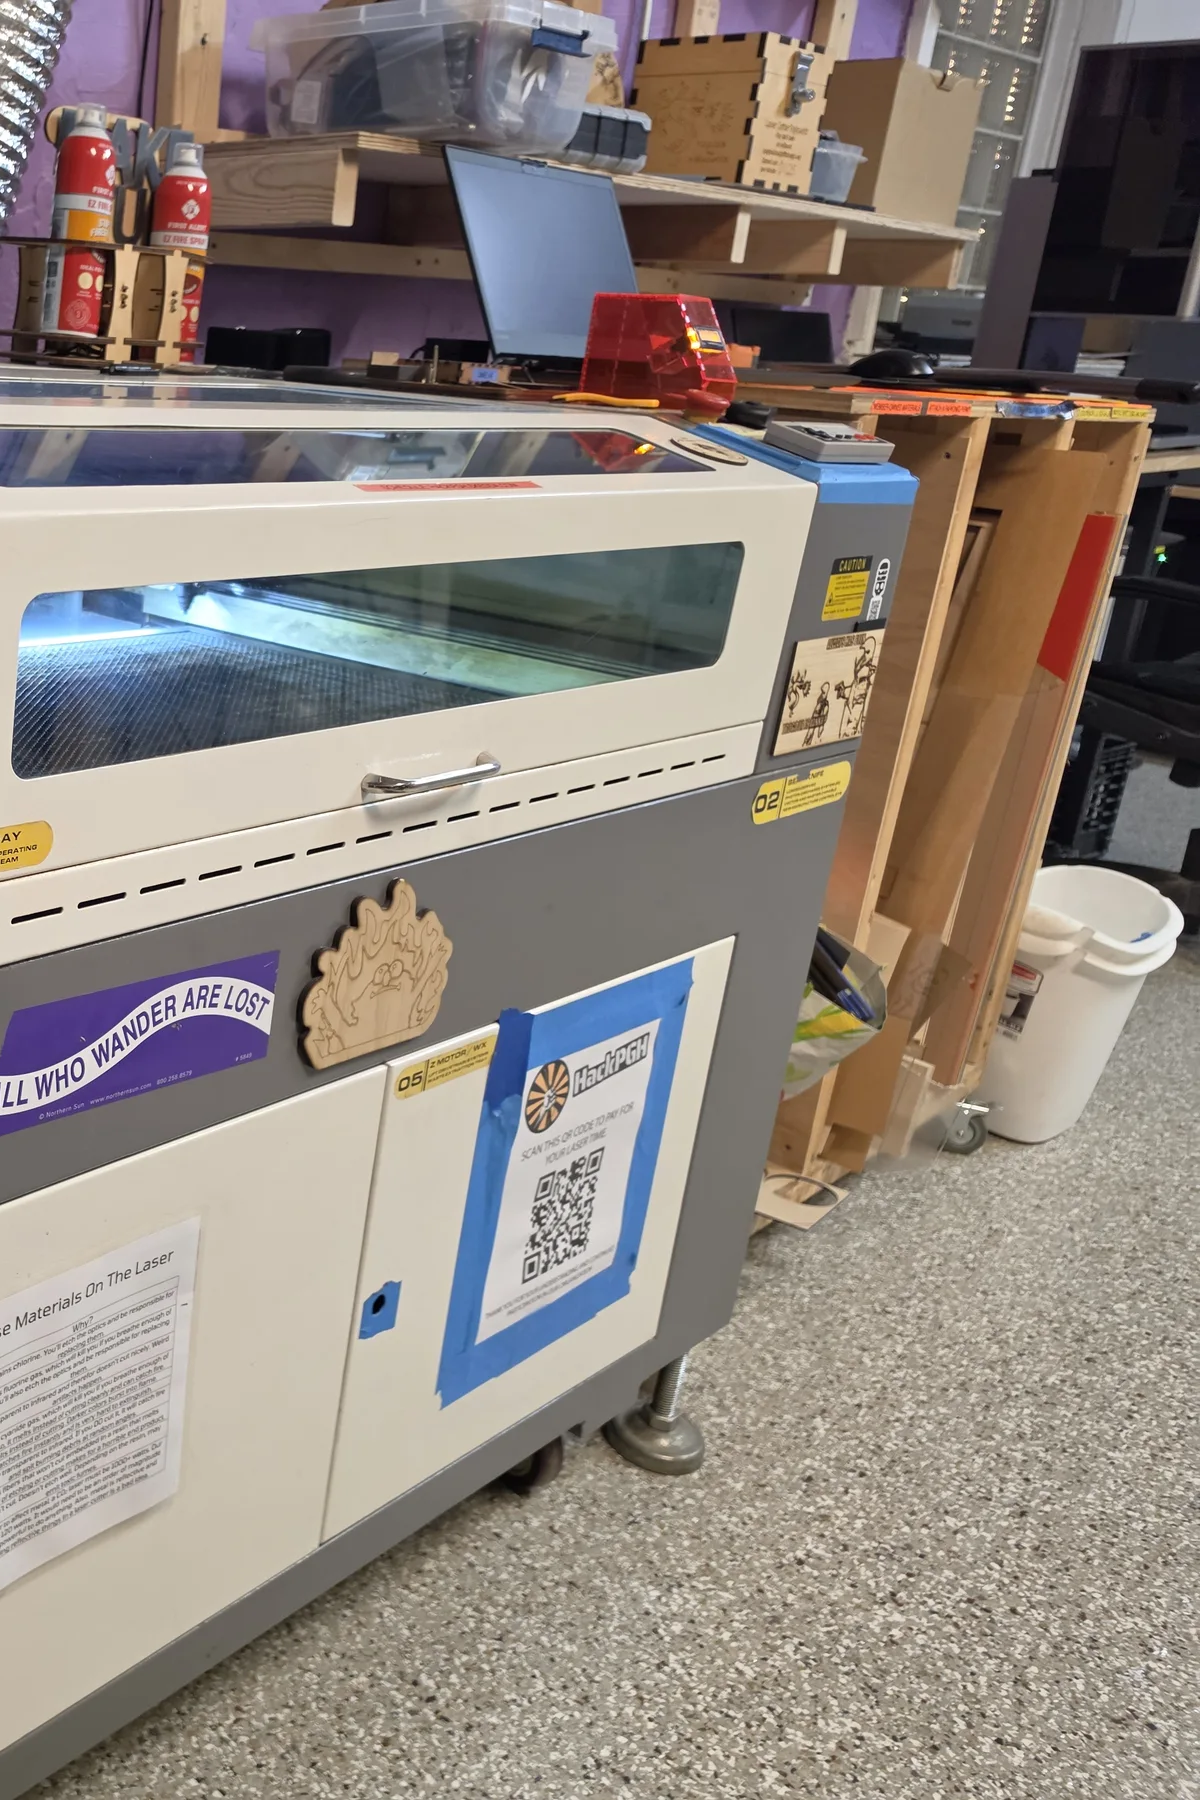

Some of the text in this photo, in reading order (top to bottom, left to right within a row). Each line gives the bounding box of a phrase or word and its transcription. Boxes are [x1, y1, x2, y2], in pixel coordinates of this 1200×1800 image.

[173, 236, 189, 244] FIRE
[839, 558, 866, 572] CAUTION
[754, 790, 780, 813] 02
[34, 1056, 86, 1101] WHO
[91, 994, 178, 1069] WANDER
[182, 984, 222, 1014] ARE
[223, 984, 271, 1022] LOST
[437, 1049, 466, 1065] MOTOR
[398, 1071, 423, 1092] 05
[572, 1032, 650, 1098] HackPGH
[46, 1103, 72, 1118] Northern
[73, 1101, 85, 1110] Sun
[89, 1083, 152, 1105] www.northernsun.com
[521, 1101, 634, 1162] SCAN THIS QR CODE TO PAY FOR
[545, 1128, 607, 1165] YOUR LASER TIME
[15, 1291, 82, 1330] Materials
[85, 1281, 104, 1298] On
[107, 1268, 132, 1287] The
[135, 1251, 174, 1275] Laser
[13, 1351, 41, 1371] chlorine.
[43, 1342, 60, 1357] You'll
[62, 1335, 75, 1348] etch
[76, 1330, 86, 1340] the
[88, 1320, 106, 1335] optics
[107, 1314, 119, 1325] and
[120, 1310, 127, 1319] be
[129, 1293, 164, 1315] responsible
[165, 1289, 174, 1298] for
[72, 1315, 93, 1333] Why?
[3, 1375, 28, 1394] fluorine
[45, 1358, 65, 1373] which
[66, 1352, 76, 1363] will
[77, 1347, 85, 1357] kill
[86, 1342, 98, 1353] you
[104, 1334, 115, 1345] you
[116, 1321, 139, 1338] breathe
[141, 1310, 164, 1328] enough
